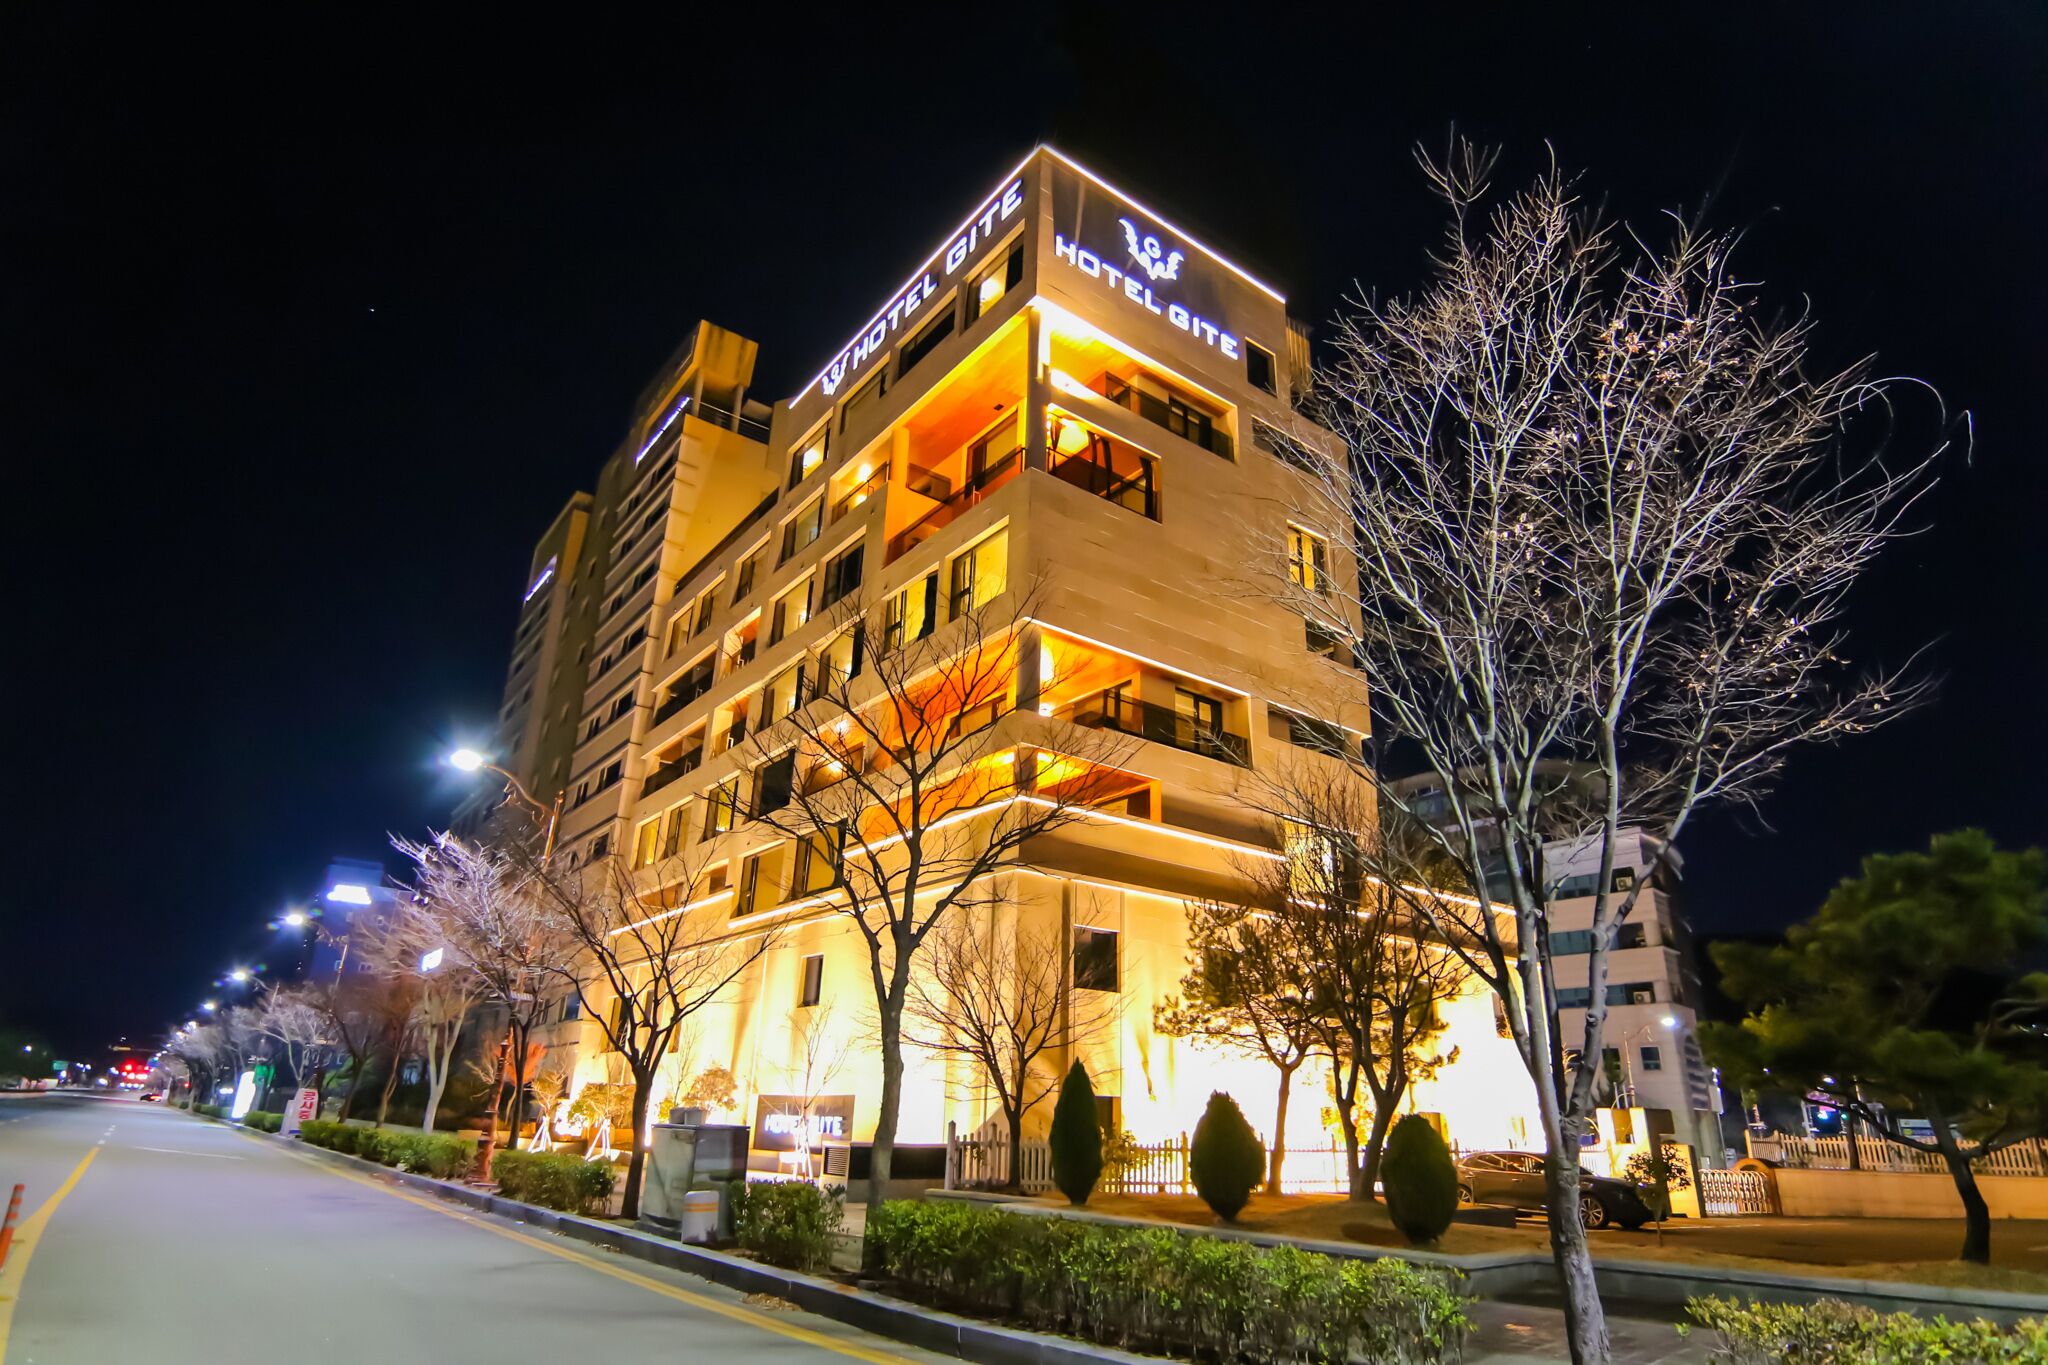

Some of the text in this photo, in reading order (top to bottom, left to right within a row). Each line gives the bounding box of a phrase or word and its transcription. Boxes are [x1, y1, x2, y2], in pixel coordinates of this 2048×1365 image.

[852, 178, 1024, 369] HOTEL GITE
[1055, 235, 1239, 361] HOTEL GITE
